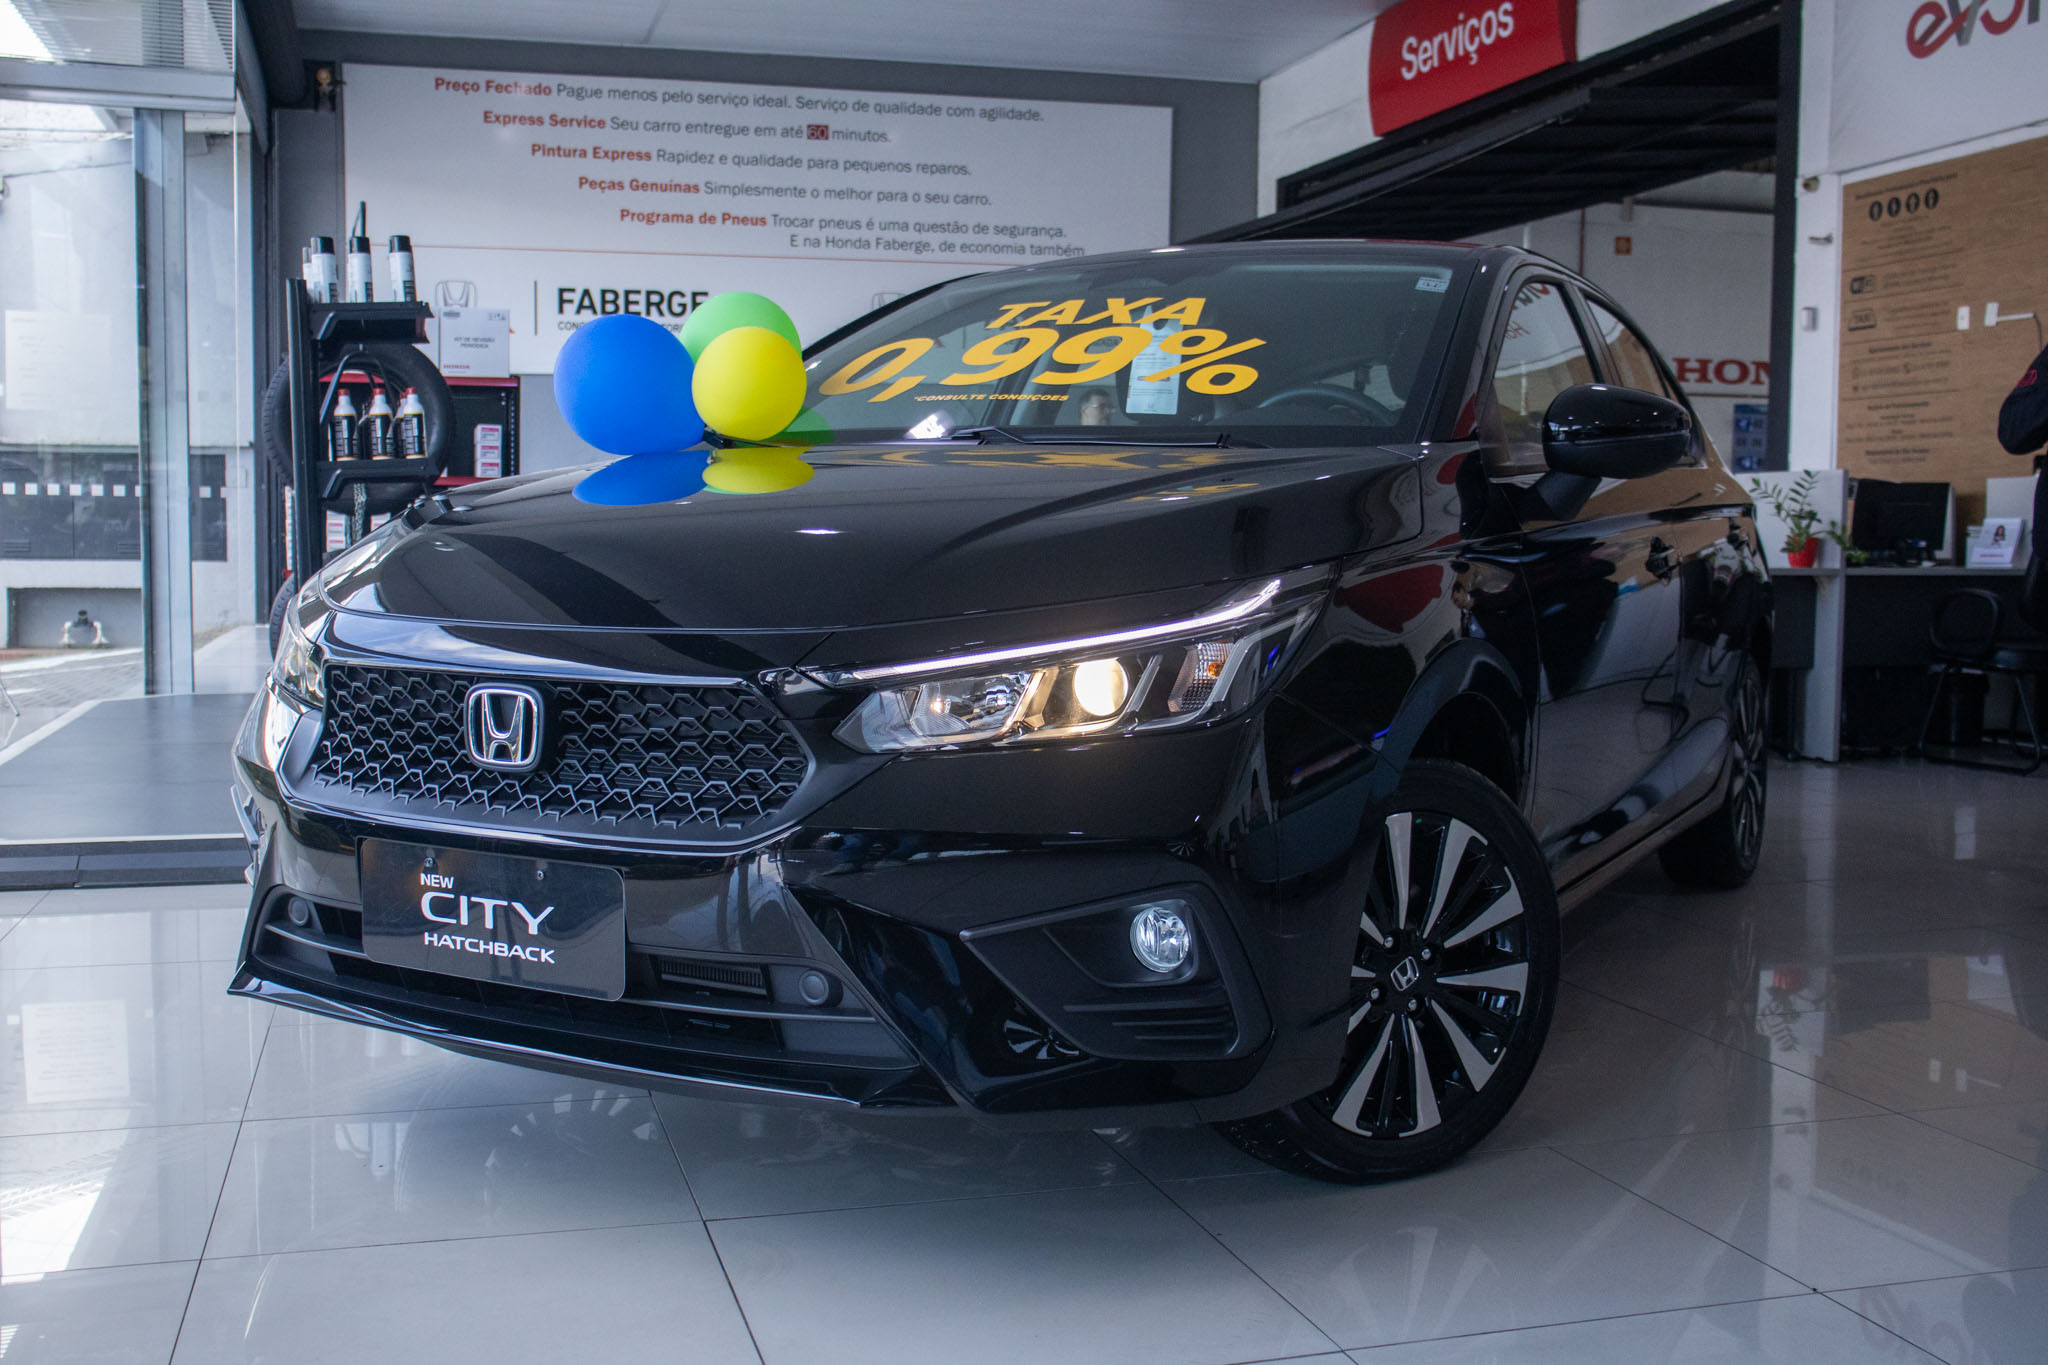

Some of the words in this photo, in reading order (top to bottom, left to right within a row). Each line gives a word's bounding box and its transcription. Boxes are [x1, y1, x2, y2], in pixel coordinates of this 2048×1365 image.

[1401, 1, 1514, 80] Serviços
[435, 77, 480, 95] Preço
[485, 79, 552, 96] Fechado
[556, 83, 603, 100] Pague
[607, 88, 657, 101] menos
[662, 90, 693, 104] pelo
[697, 92, 749, 108] serviço
[753, 94, 792, 108] ideal.
[795, 96, 848, 113] Serviço
[852, 99, 869, 112] de
[873, 101, 942, 116] qualidade
[946, 105, 975, 118] com
[979, 105, 1044, 122] agilidade.
[483, 110, 544, 127] Express
[548, 113, 606, 129] Service
[610, 116, 639, 131] Seu
[643, 119, 681, 133] carro
[685, 121, 749, 138] entregue
[754, 125, 776, 137] em
[781, 125, 803, 139] até
[808, 126, 828, 139] 60
[831, 129, 891, 143] minutos.
[531, 143, 587, 159] Pintura
[592, 146, 652, 162] Express
[656, 148, 714, 165] Rapidez
[718, 153, 727, 165] e
[732, 153, 803, 169] qualidade
[807, 158, 839, 170] para
[843, 159, 912, 173] pequenos
[916, 162, 972, 176] reparos.
[578, 176, 625, 193] Peças
[704, 181, 806, 198] Simplesmente
[811, 188, 819, 199] o
[824, 188, 872, 201] melhor
[876, 190, 908, 203] para
[912, 192, 921, 203] o
[924, 192, 949, 204] seu
[953, 193, 992, 206] carro.
[620, 208, 694, 225] Programa
[698, 211, 717, 225] de
[721, 212, 767, 227] Pneus
[771, 214, 815, 228] Trocar
[819, 218, 862, 231] pneus
[865, 218, 875, 231] é
[879, 220, 909, 232] uma
[914, 221, 969, 235] questão
[972, 222, 989, 235] de
[993, 224, 1067, 239] segurança.
[790, 235, 799, 247] E
[803, 237, 821, 248] na
[825, 236, 871, 250] Honda
[875, 237, 934, 254] Faberge,
[938, 240, 956, 253] de
[960, 242, 1026, 255] economia
[1030, 243, 1085, 257] também
[557, 288, 709, 317] FABERGE
[985, 297, 1206, 329] TAXA
[819, 326, 1267, 402] 0,99%
[420, 873, 454, 888] NEW
[420, 891, 555, 935] CITY
[424, 932, 555, 964] HATCHBACK
